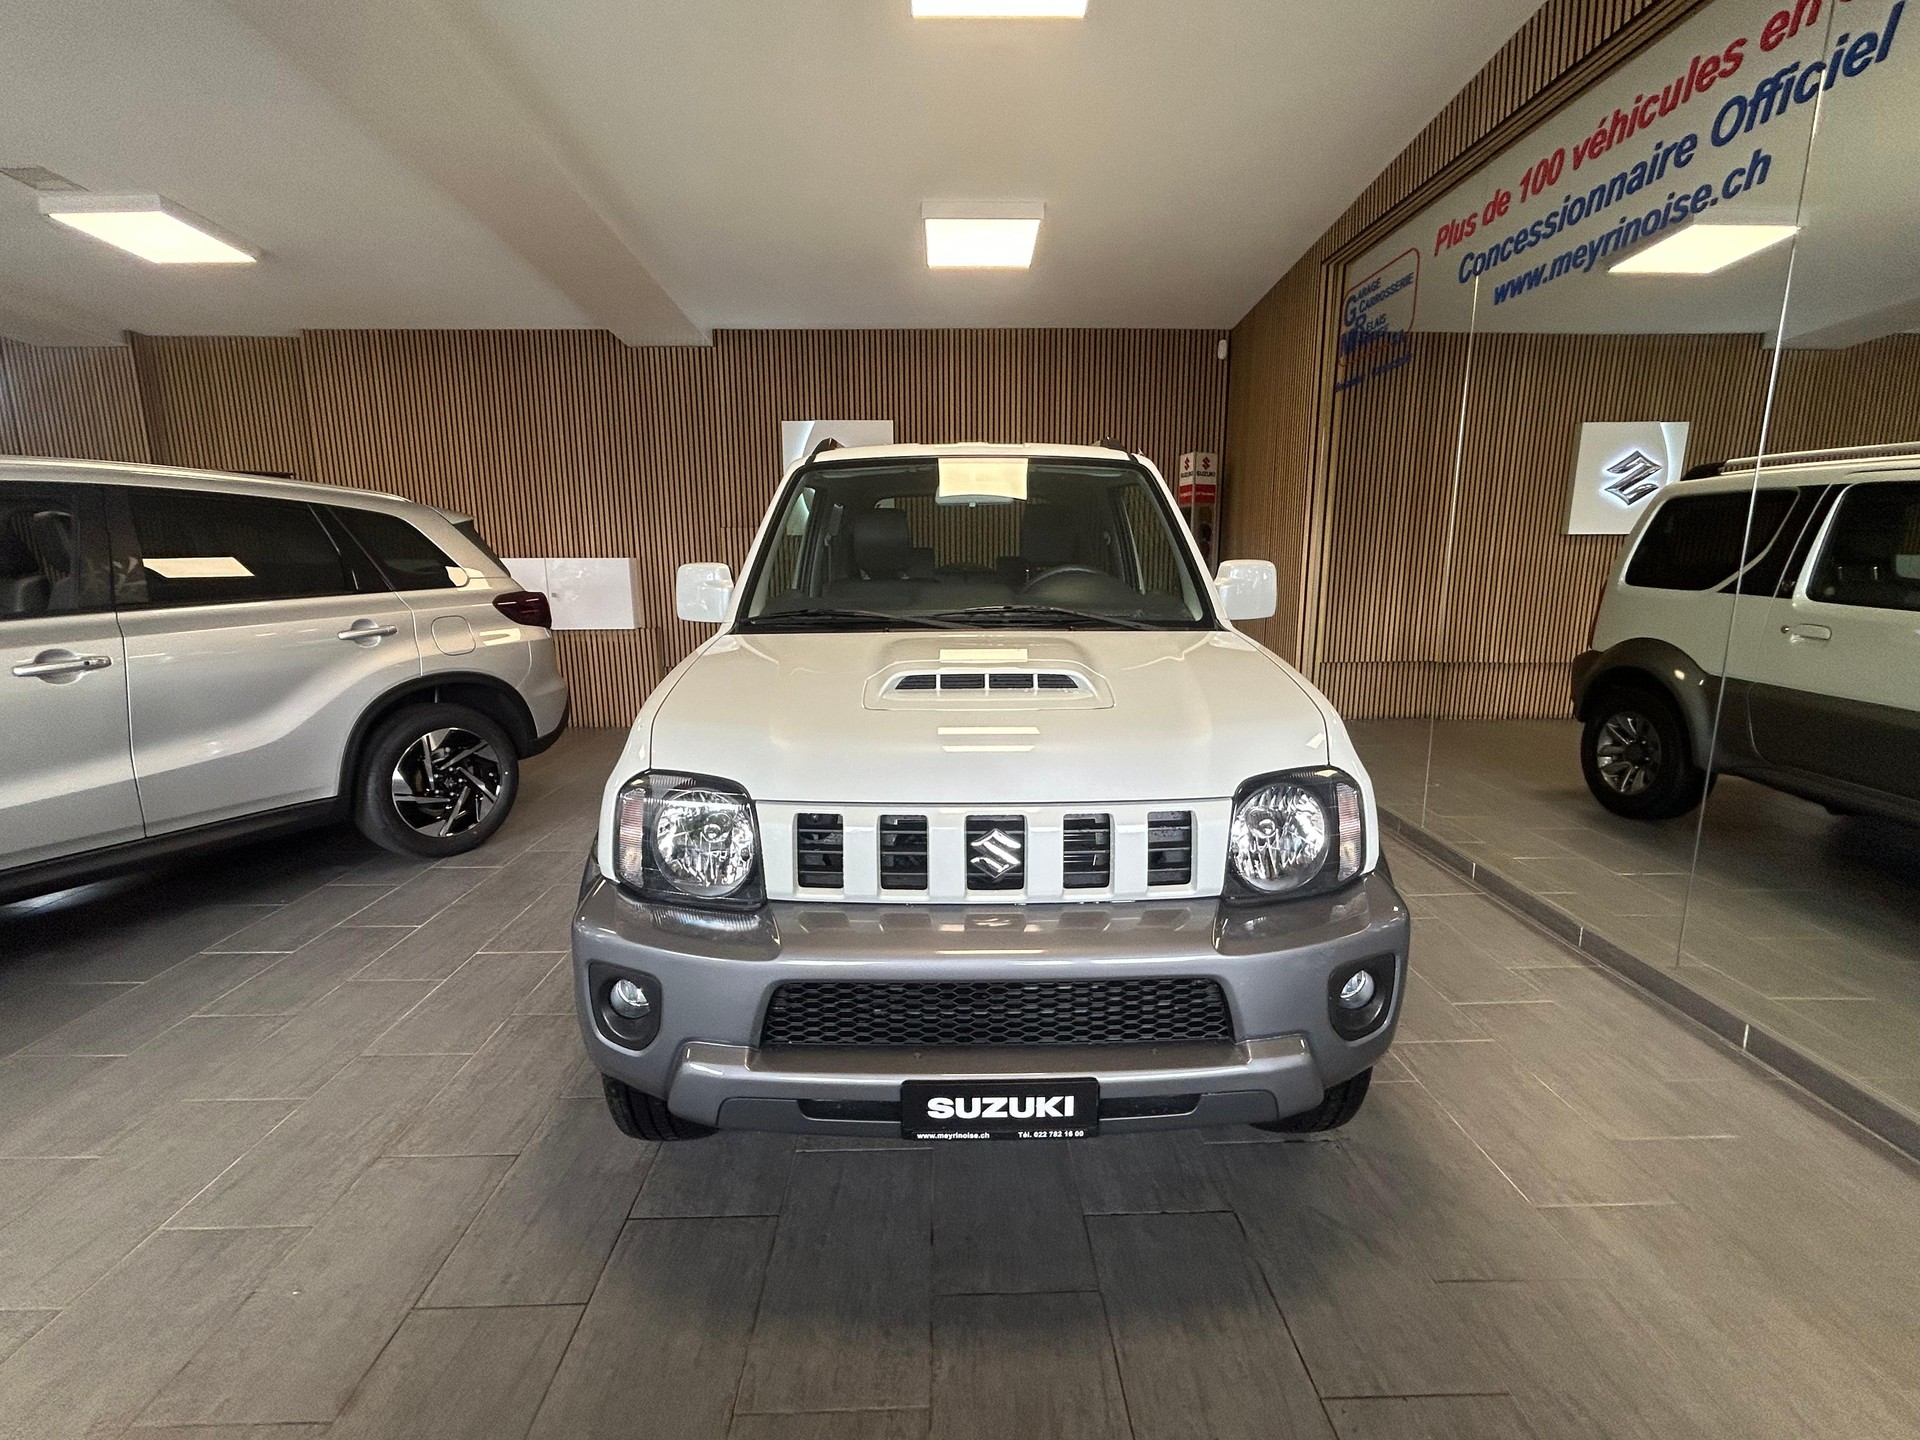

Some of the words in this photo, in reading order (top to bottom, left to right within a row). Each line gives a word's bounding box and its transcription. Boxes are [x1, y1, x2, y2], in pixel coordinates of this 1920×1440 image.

[1434, 212, 1478, 257] Plus
[1481, 188, 1512, 227] de
[1519, 147, 1566, 203] 100
[1572, 37, 1748, 170] véhicules
[1759, 0, 1821, 52] en
[1458, 132, 1698, 284] Concessionnaire
[1710, 0, 1906, 147] Officiel
[1493, 148, 1772, 306] www.meyrinoise.ch
[917, 1131, 990, 1140] www.meyrinoise.ch
[927, 1095, 1075, 1120] SUZUKI
[1018, 1131, 1032, 1139] Tél.
